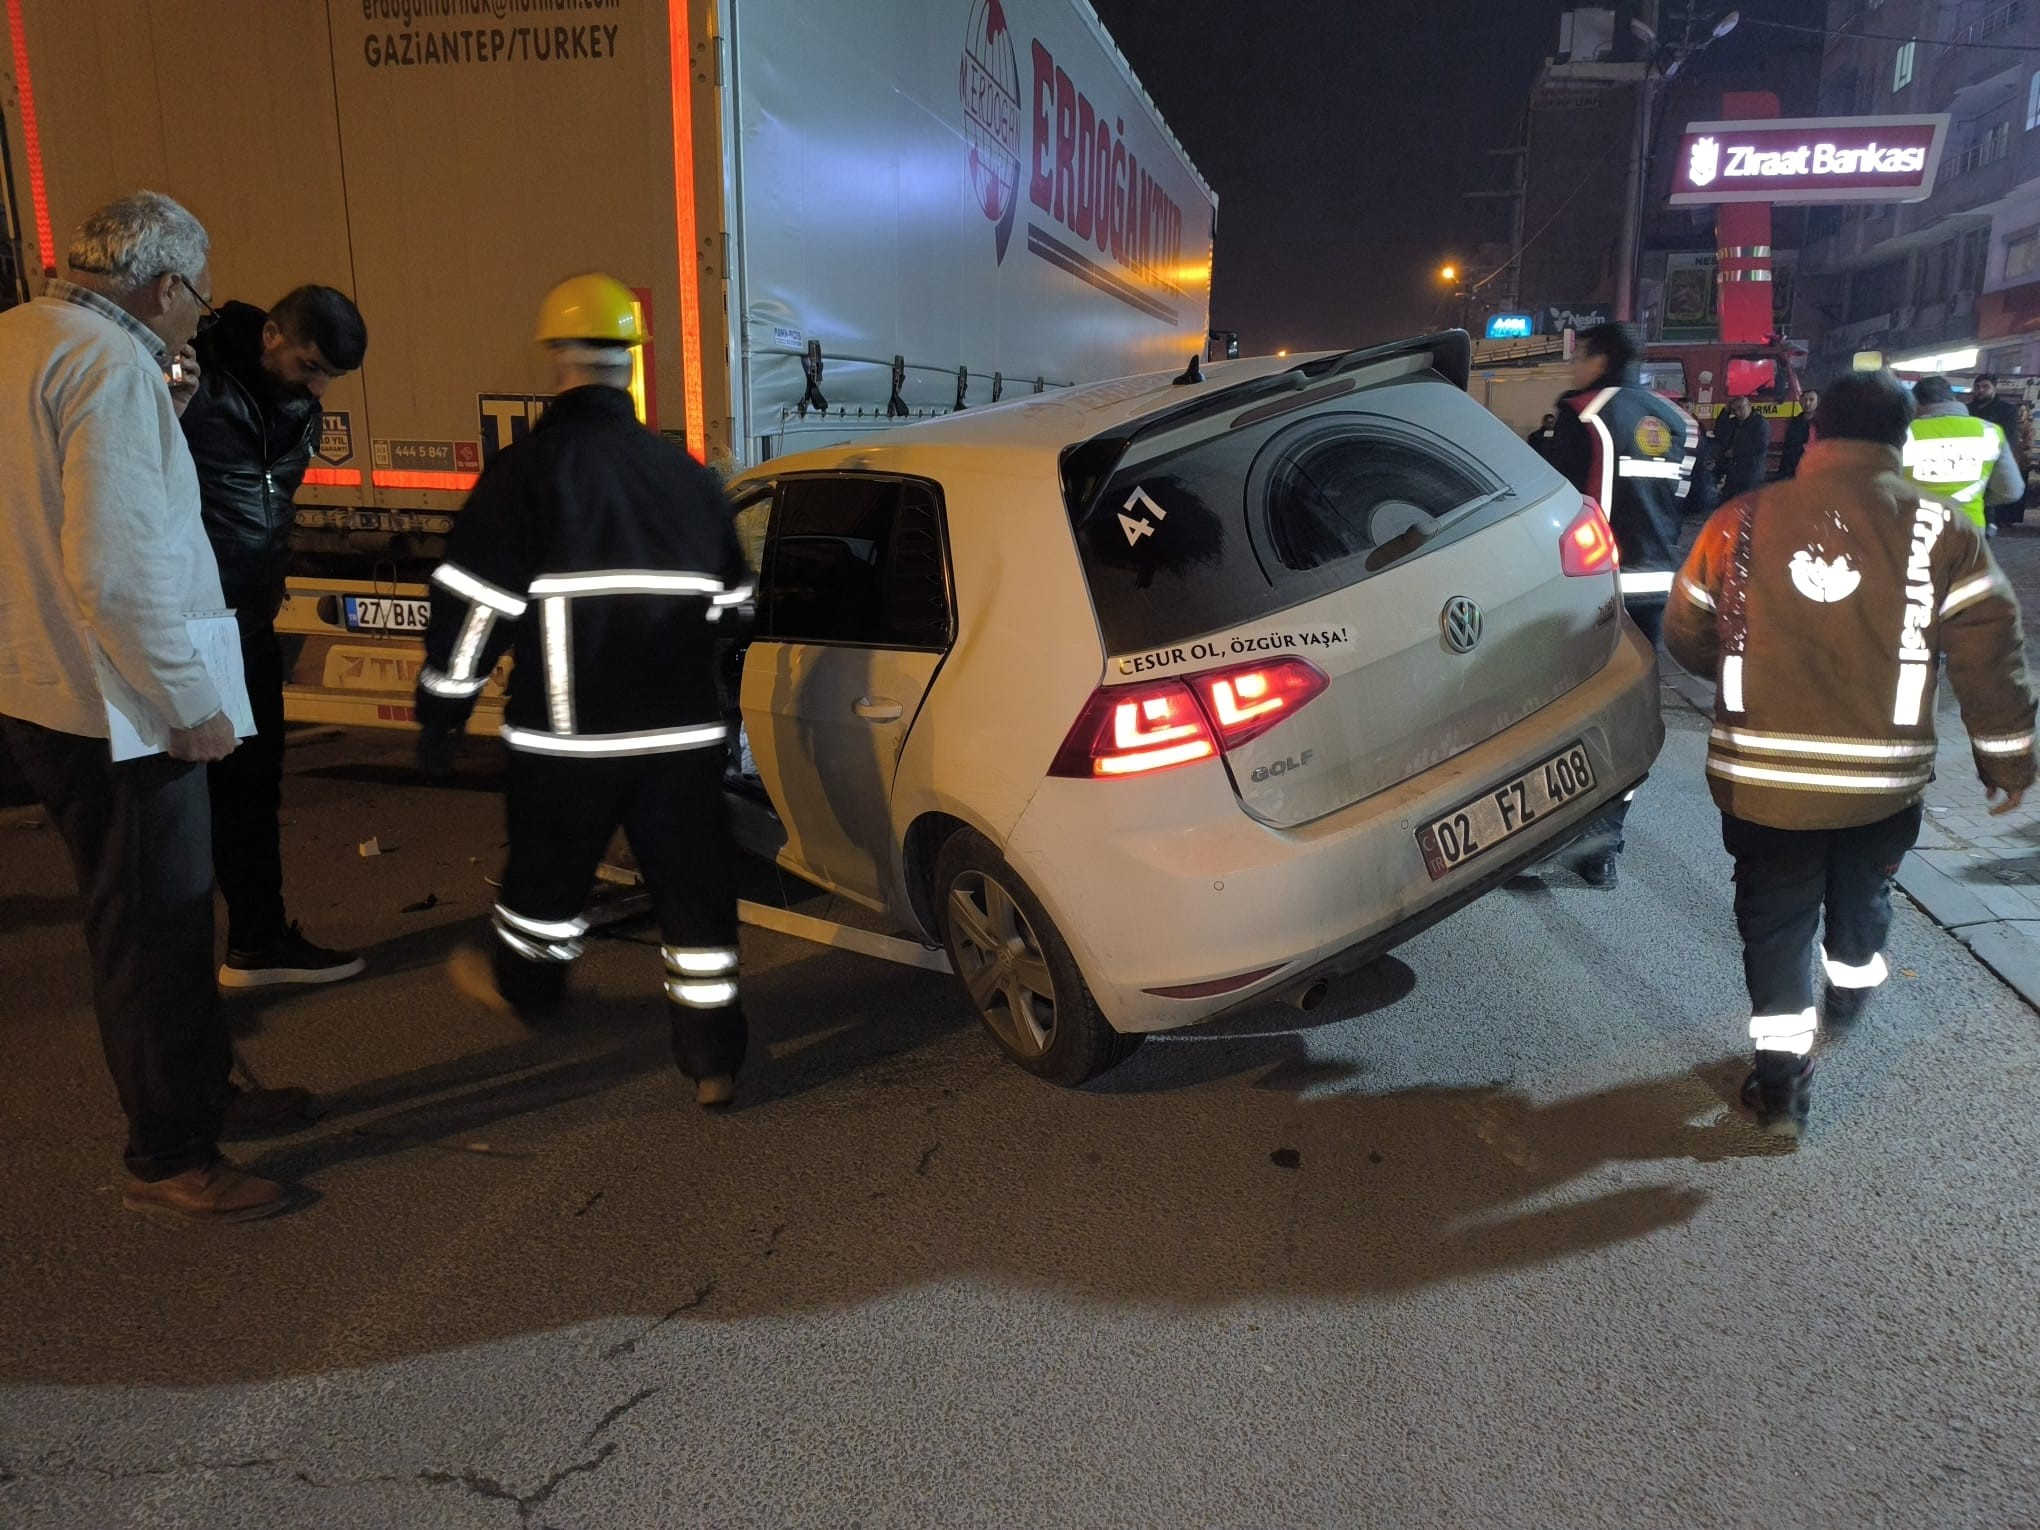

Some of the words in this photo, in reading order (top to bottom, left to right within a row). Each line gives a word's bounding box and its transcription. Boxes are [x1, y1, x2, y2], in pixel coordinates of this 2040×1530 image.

[1724, 145, 1810, 176] Ziraat
[1812, 142, 1926, 174] Bankası
[331, 436, 347, 445] YIL
[395, 446, 416, 456] 444
[419, 446, 426, 457] 5
[429, 446, 448, 458] 847
[1117, 486, 1167, 547] 47
[358, 601, 380, 625] 27
[1119, 648, 1186, 675] CESUR
[1191, 642, 1225, 659] OL,
[1230, 632, 1296, 653] ÖZGÜR
[1299, 628, 1348, 649] YAŞA!
[1251, 749, 1313, 783] GOLF
[1437, 813, 1479, 862] 02
[1494, 781, 1535, 832] FZ
[1544, 750, 1590, 803] 408
[1428, 857, 1445, 873] TR
